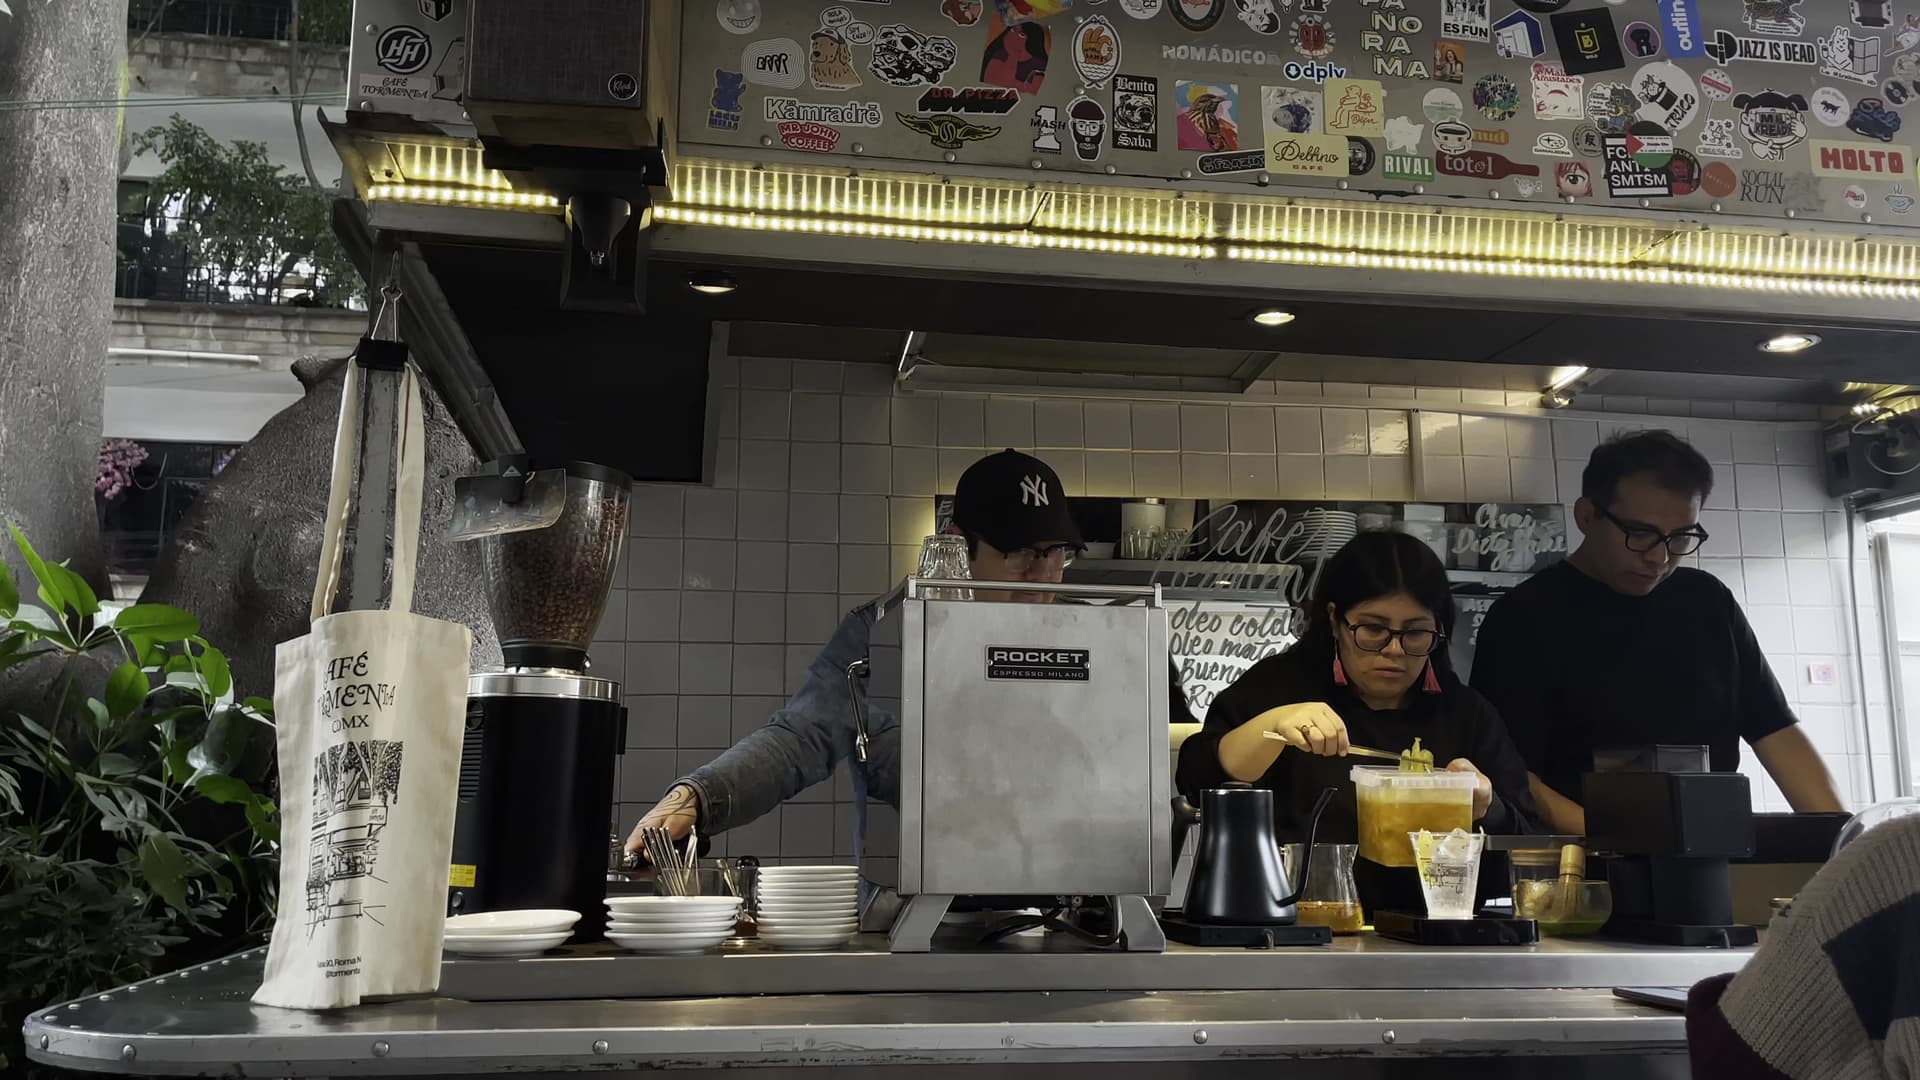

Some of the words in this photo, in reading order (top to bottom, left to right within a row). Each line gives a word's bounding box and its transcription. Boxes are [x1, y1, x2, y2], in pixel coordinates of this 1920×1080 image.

[1443, 23, 1460, 35] ES
[1462, 24, 1489, 38] FUN
[1738, 42, 1767, 59] JAZZ
[1769, 43, 1781, 60] IS
[1787, 44, 1815, 63] DEAD
[362, 85, 428, 101] TORMENTA
[1115, 76, 1155, 93] Benito
[965, 88, 1018, 100] PIZZA
[1664, 93, 1696, 129] TRUCO
[803, 123, 838, 141] JOHN
[1030, 118, 1066, 130] MASH
[788, 138, 829, 150] COFFEE
[1117, 133, 1152, 149] Saba
[1273, 139, 1339, 164] Delfino
[1384, 155, 1433, 176] RIVAL
[1609, 160, 1651, 173] ANT
[1820, 147, 1904, 174] MOLTO
[1611, 174, 1667, 187] SMTSM
[1742, 169, 1785, 188] SOCIAL
[1740, 185, 1785, 204] RUN
[1019, 474, 1050, 507] NY
[1229, 608, 1290, 638] cold
[993, 650, 1084, 664] ROCKET
[324, 651, 369, 685] AFÉ
[993, 669, 1044, 677] ESPRESSO
